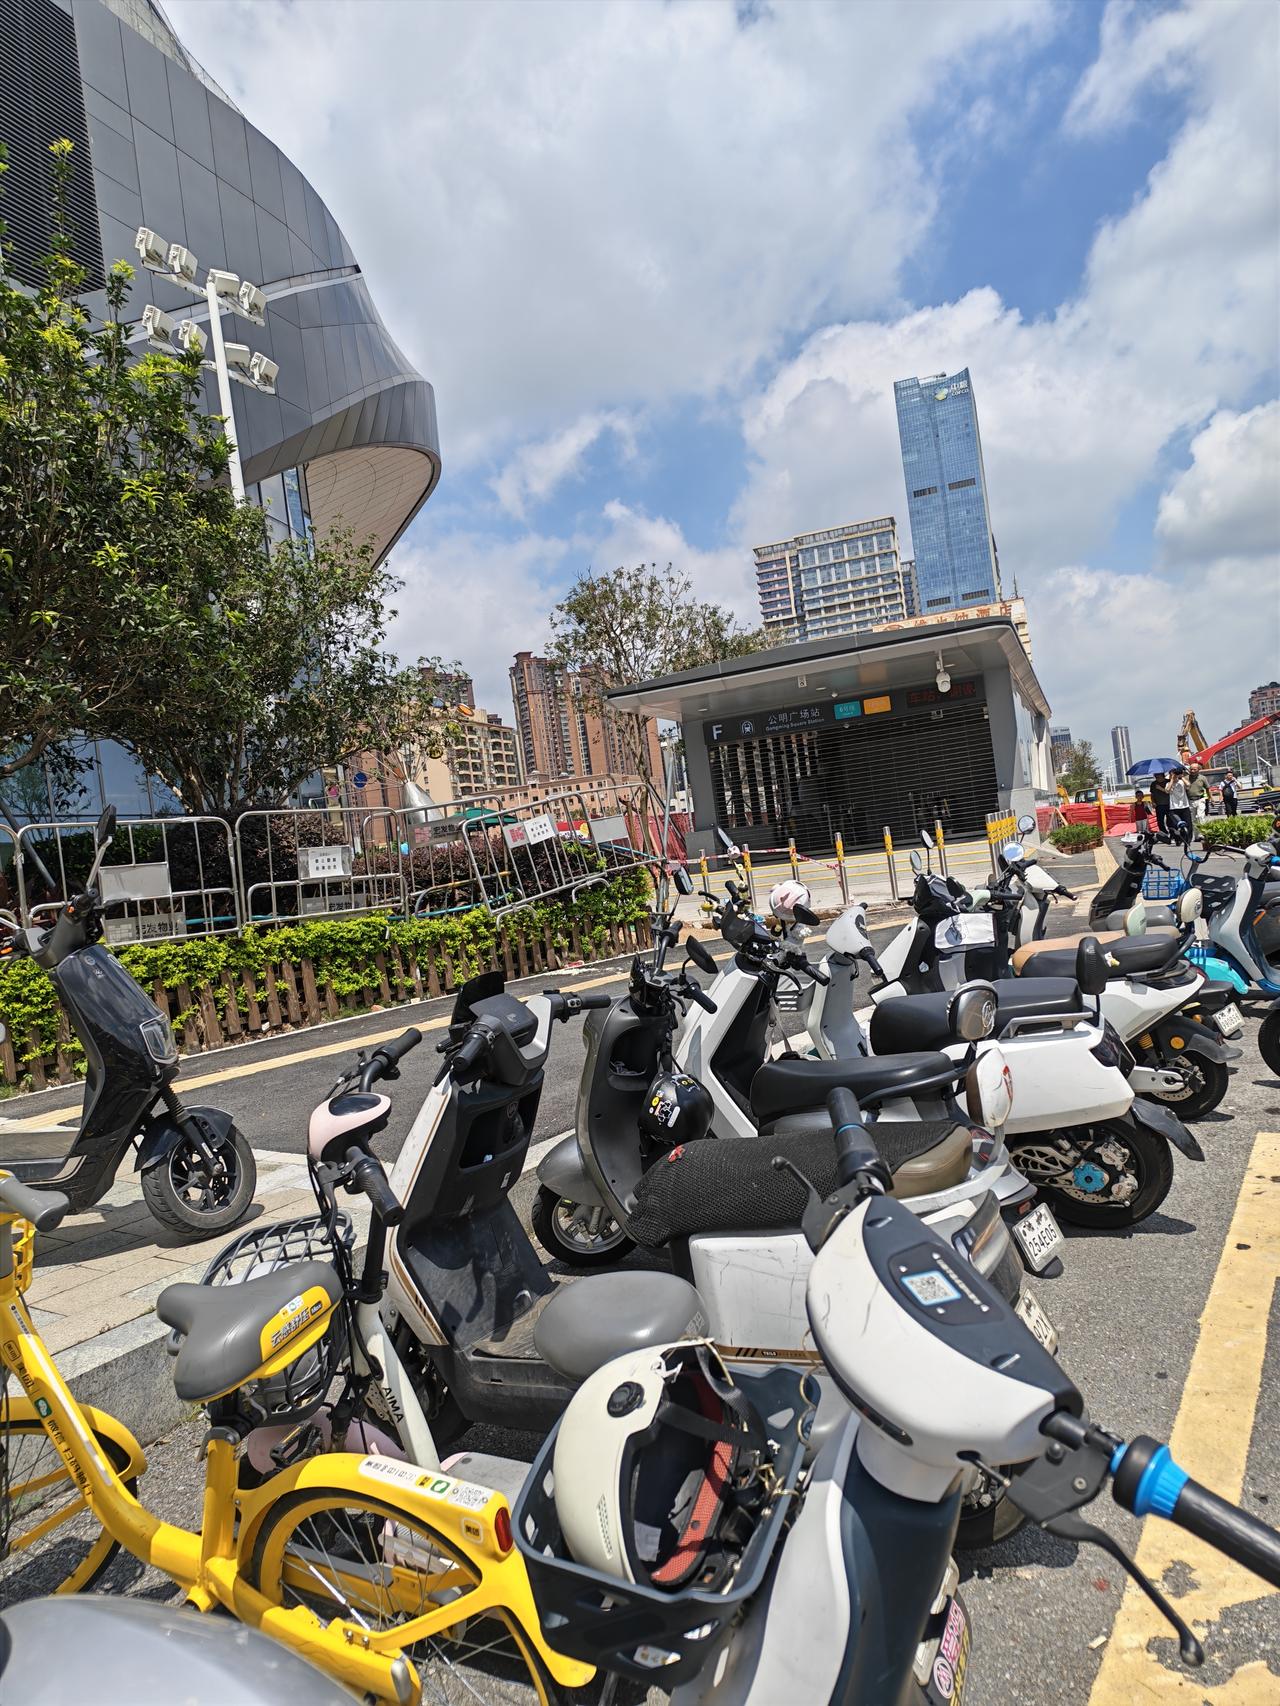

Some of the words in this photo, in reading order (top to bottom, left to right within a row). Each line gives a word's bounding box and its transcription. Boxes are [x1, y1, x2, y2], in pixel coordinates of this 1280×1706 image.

[768, 708, 820, 725] 公明广场站
[712, 724, 723, 740] F
[1028, 1224, 1057, 1257] 254E05
[382, 1387, 405, 1423] AIMA
